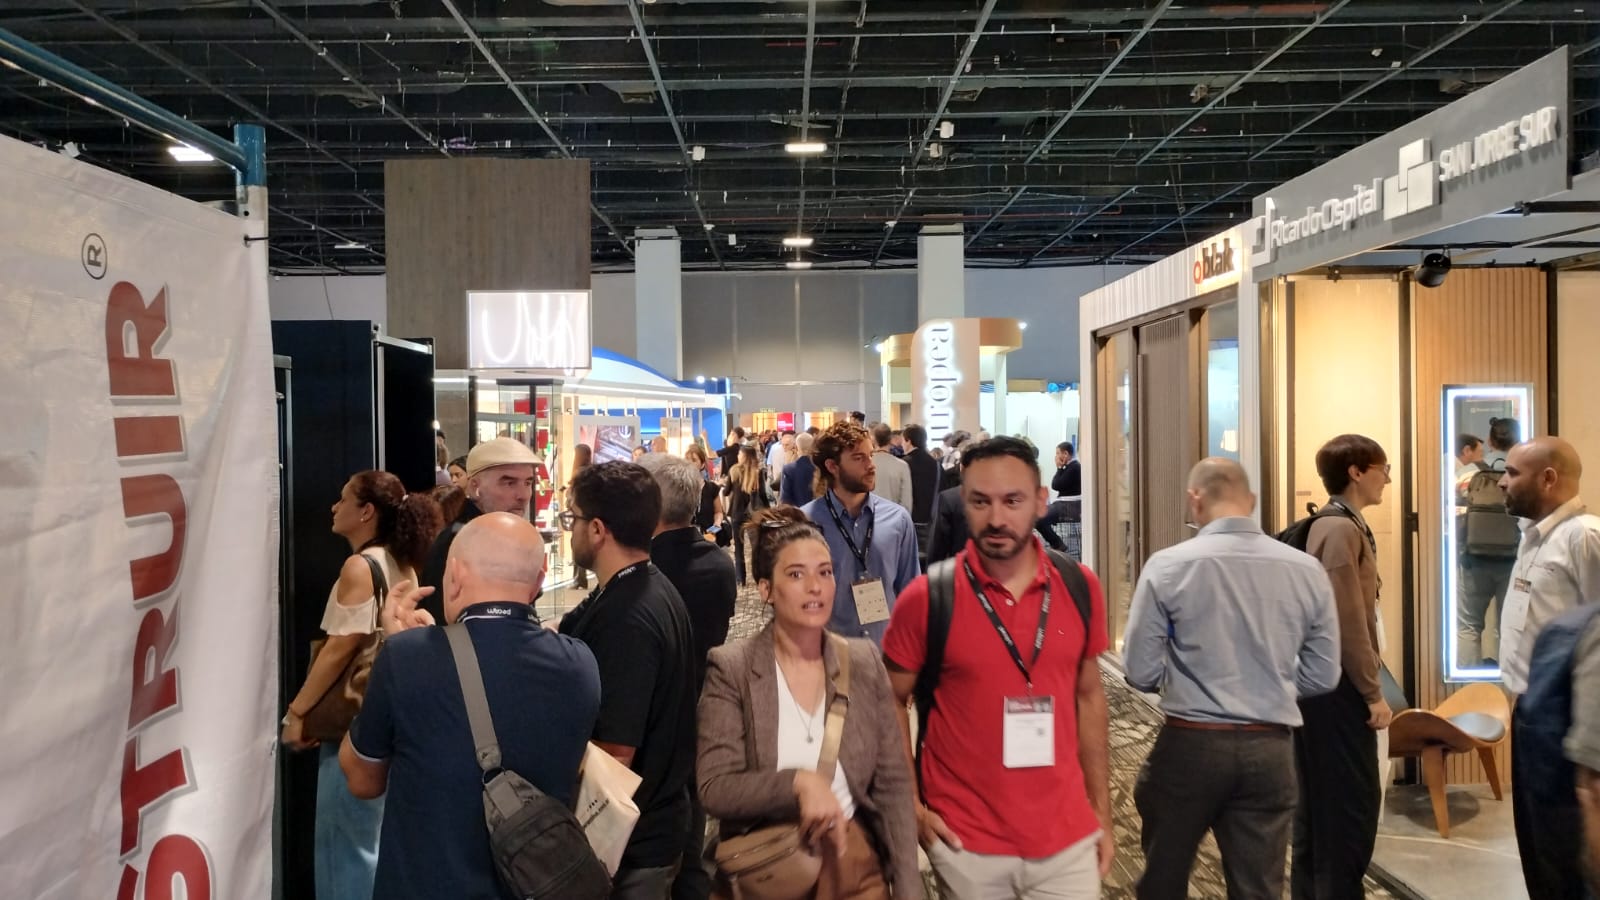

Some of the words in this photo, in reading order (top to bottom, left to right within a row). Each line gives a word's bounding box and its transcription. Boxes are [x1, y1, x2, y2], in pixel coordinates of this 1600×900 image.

[1439, 141, 1473, 182] SAN
[1471, 120, 1520, 170] JORGE
[1519, 106, 1558, 151] SUR
[1193, 237, 1236, 285] oblak
